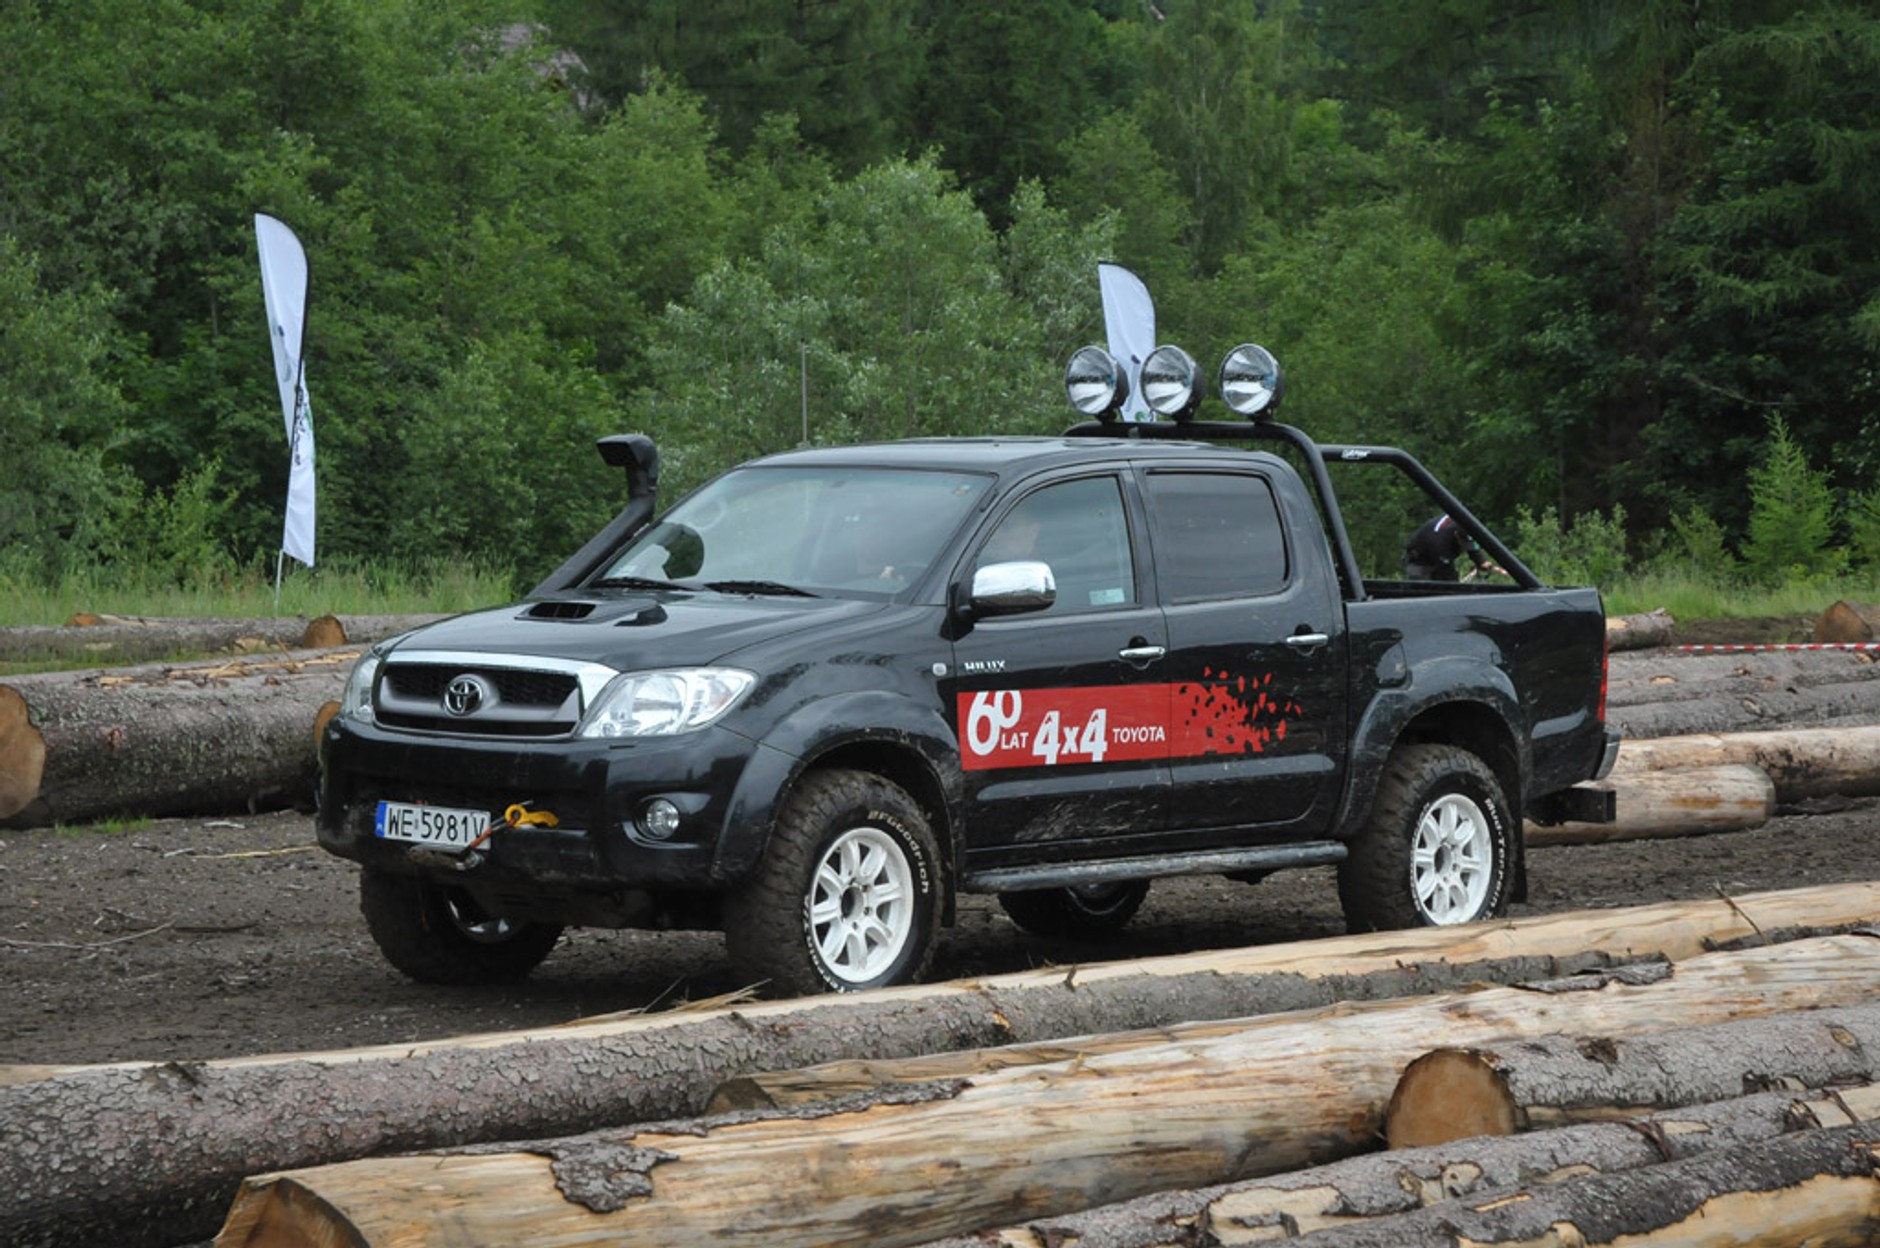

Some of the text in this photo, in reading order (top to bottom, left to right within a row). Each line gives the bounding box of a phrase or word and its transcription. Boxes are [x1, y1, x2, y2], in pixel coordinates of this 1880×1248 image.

[967, 690, 1166, 765] 60 LAT 4x4 TOYOTA
[388, 807, 486, 843] WE 5981V
